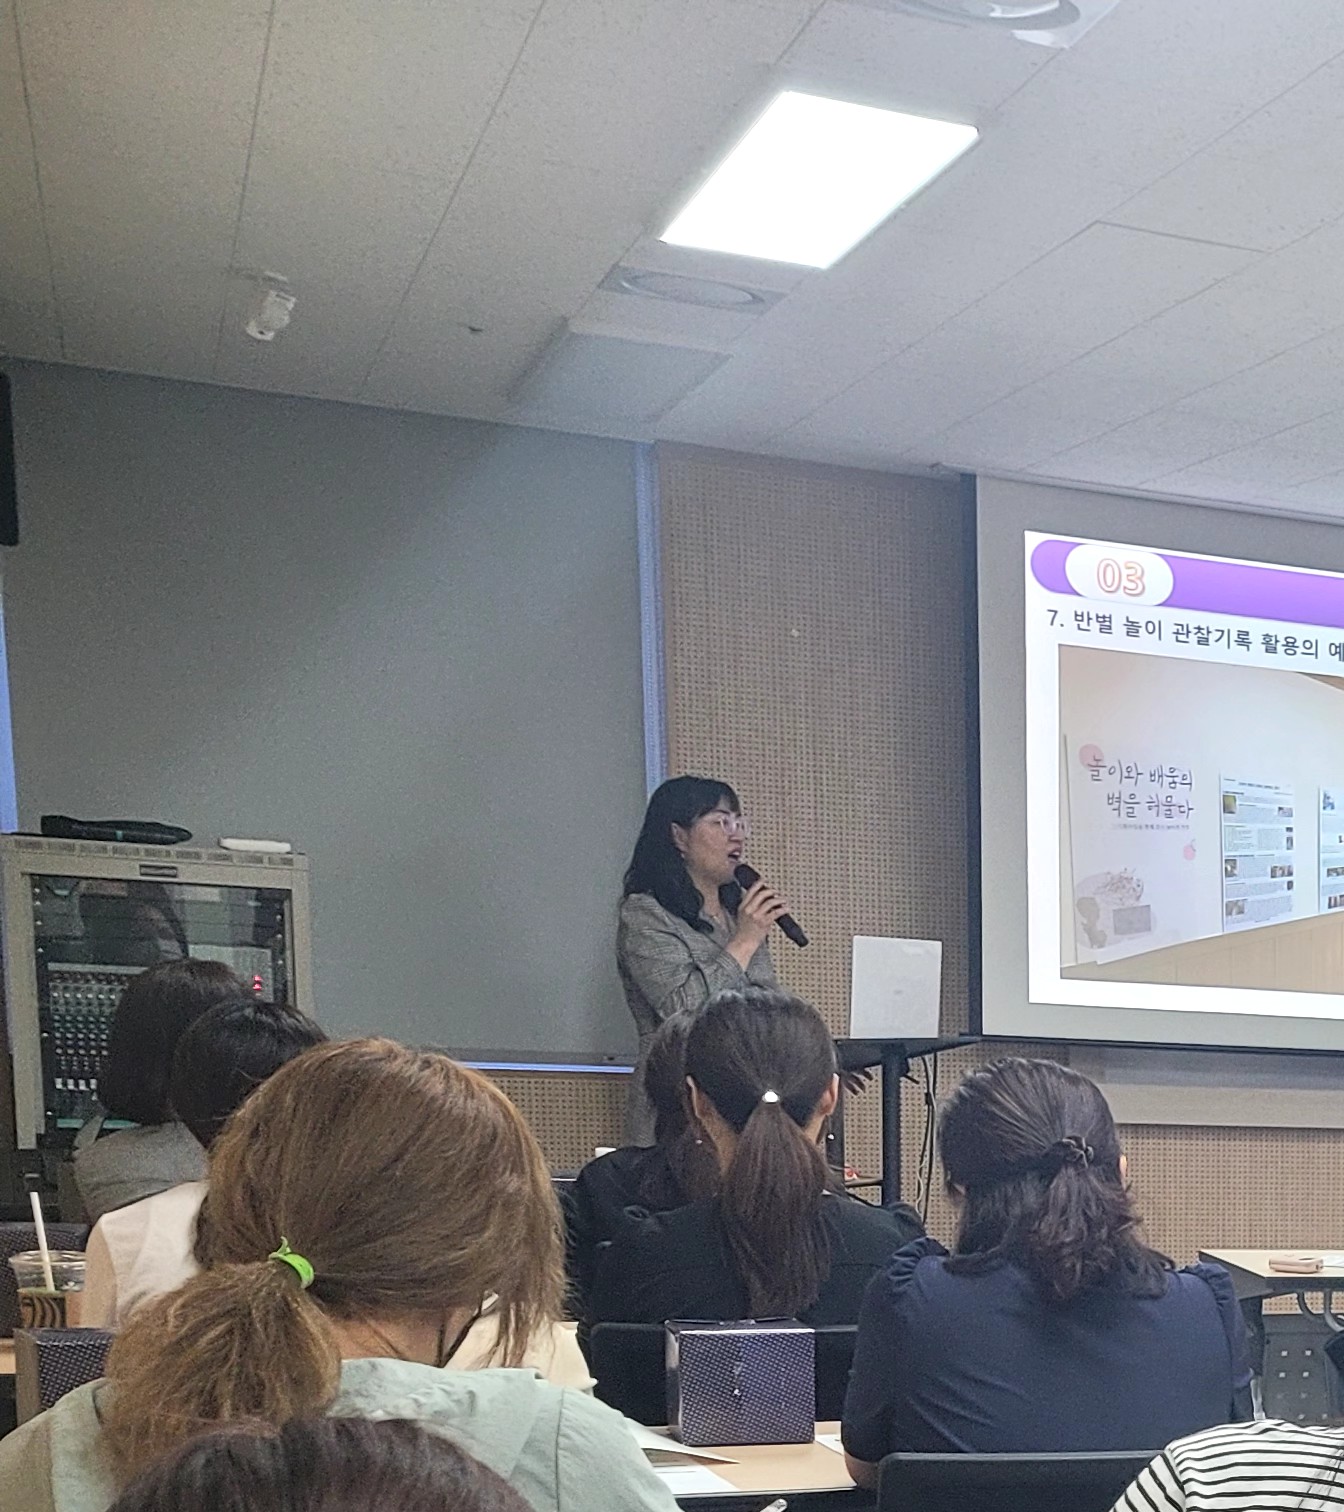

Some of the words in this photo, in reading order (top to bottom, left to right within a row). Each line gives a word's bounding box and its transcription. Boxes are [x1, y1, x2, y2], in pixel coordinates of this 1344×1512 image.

[1096, 558, 1145, 597] 03
[1047, 609, 1065, 628] 7.
[1073, 609, 1114, 635] 반별
[1122, 615, 1163, 641] 놀이
[1172, 622, 1252, 651] 관찰기록
[1261, 632, 1320, 659] 활용의
[1087, 755, 1144, 787] 놀이와
[1149, 764, 1193, 792] 배움의
[1107, 790, 1141, 818] 벽을
[1146, 793, 1194, 819] 허물다
